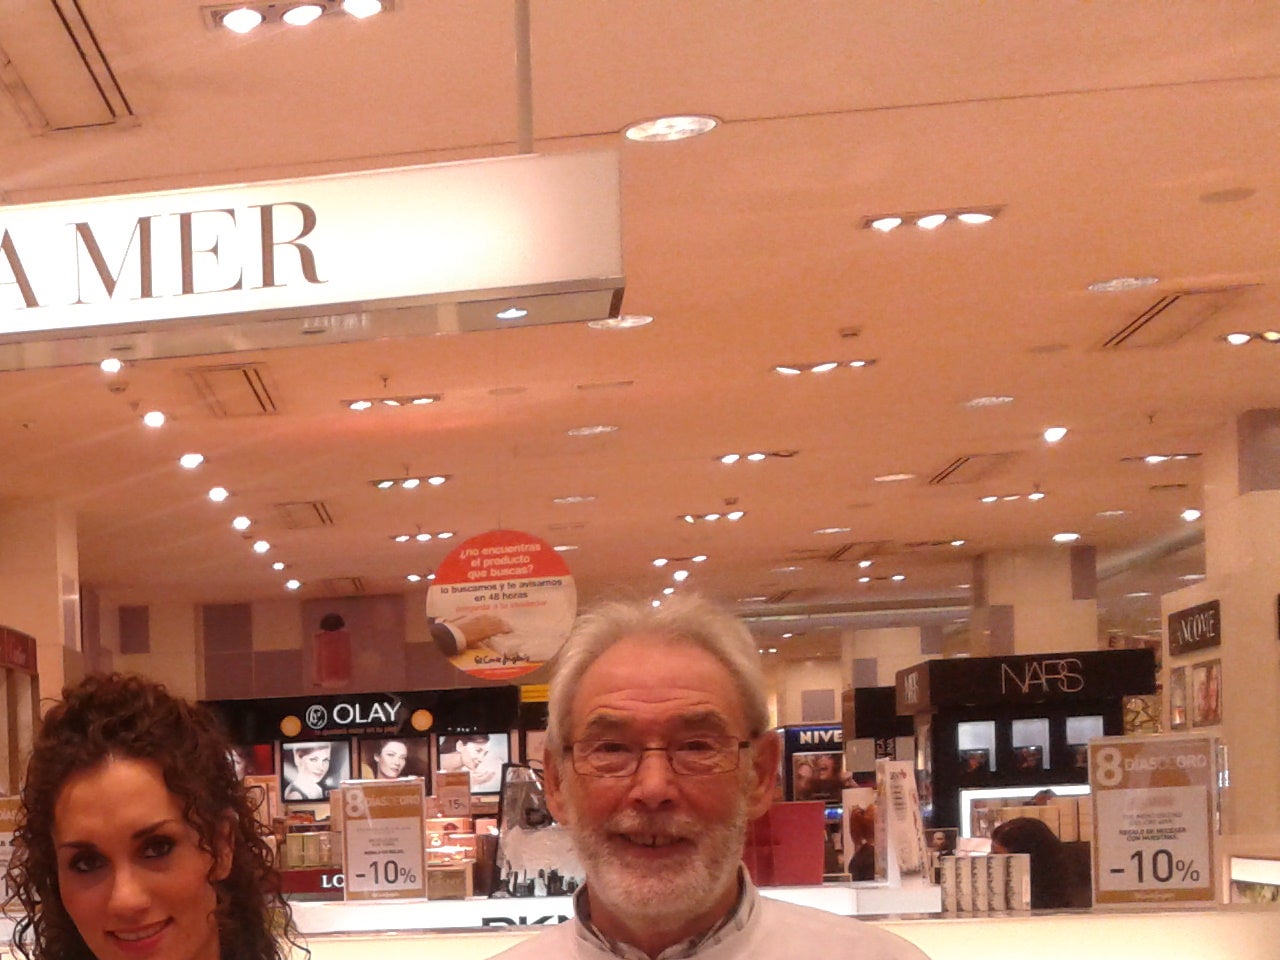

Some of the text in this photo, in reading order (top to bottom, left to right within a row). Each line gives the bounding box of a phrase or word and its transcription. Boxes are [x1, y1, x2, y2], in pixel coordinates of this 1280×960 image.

[65, 201, 329, 305] MER
[467, 565, 534, 579] que buscas?
[483, 555, 530, 568] producto
[451, 583, 497, 593] buscamos
[519, 578, 563, 588] avisamos
[502, 591, 528, 600] horas
[1001, 658, 1084, 694] NARS
[333, 701, 401, 725] OLAY
[800, 730, 843, 745] NIVE
[1096, 747, 1122, 787] 8
[345, 788, 365, 817] 8
[356, 860, 416, 885] -10%
[1110, 849, 1200, 883] -10%
